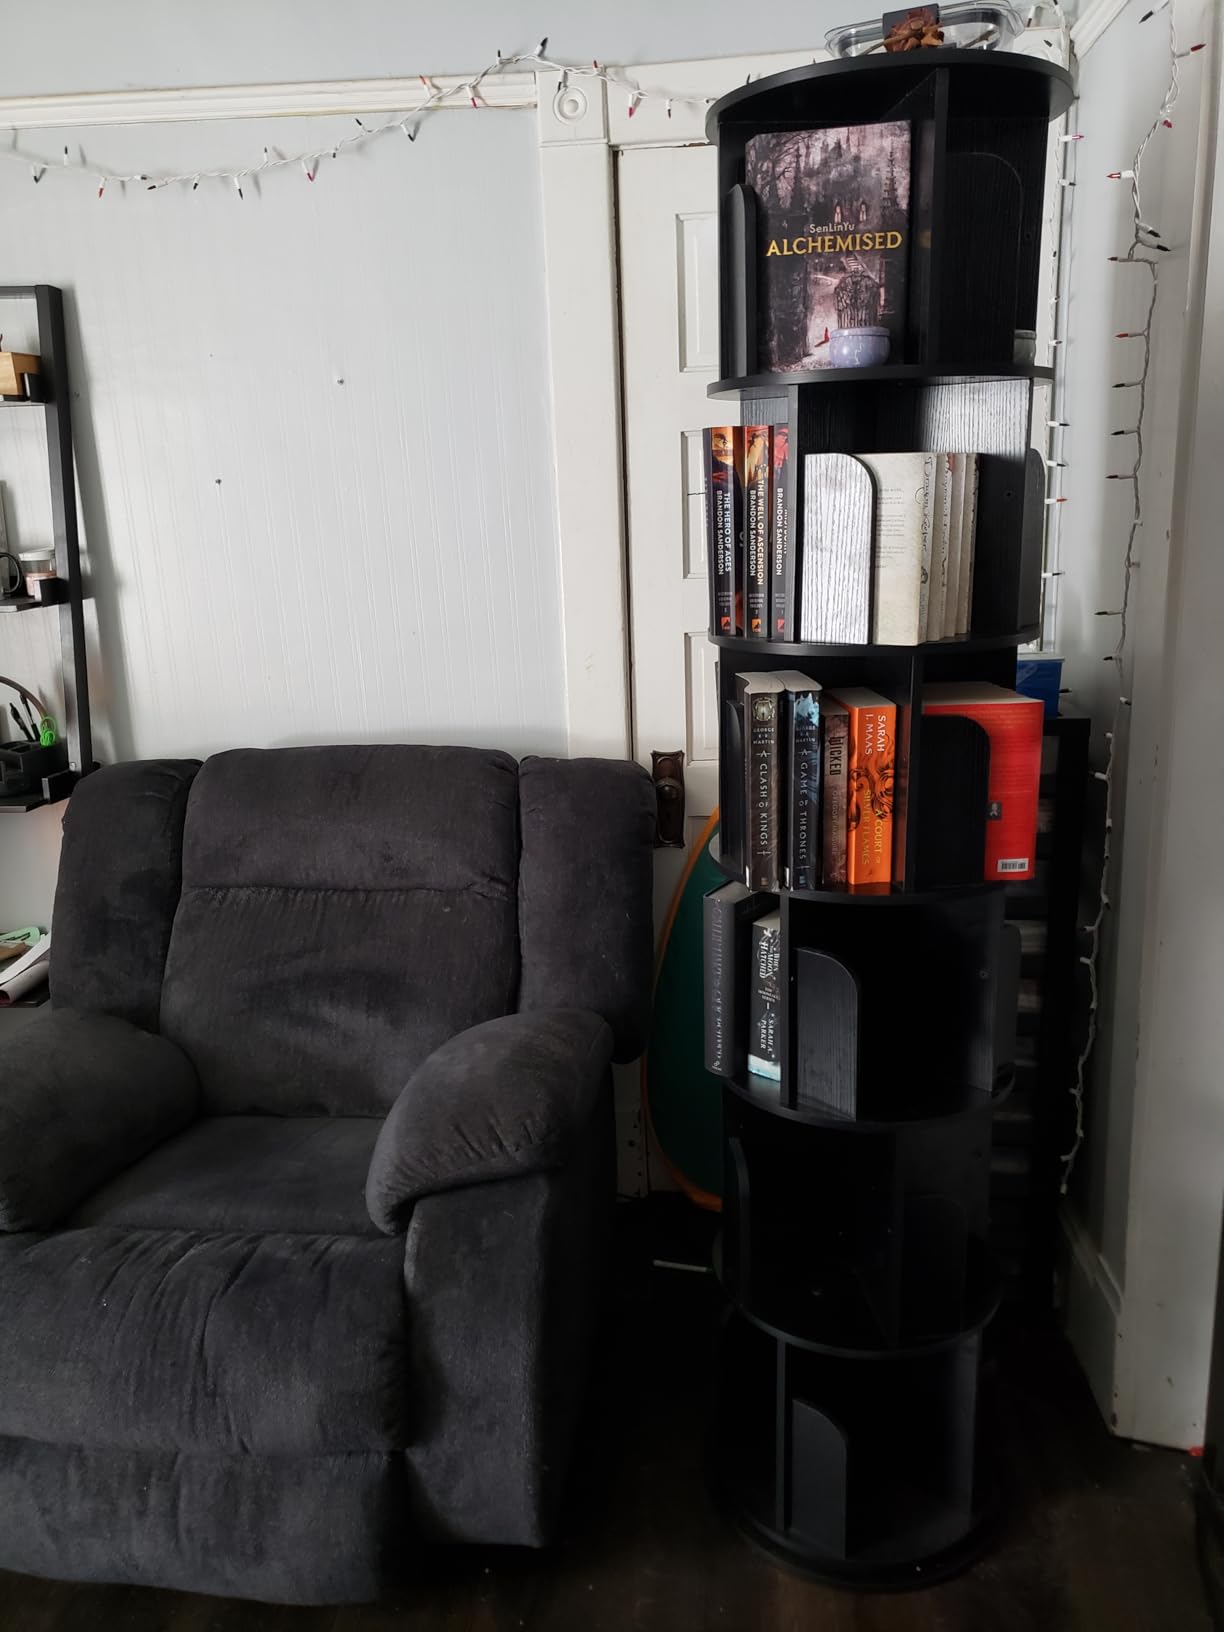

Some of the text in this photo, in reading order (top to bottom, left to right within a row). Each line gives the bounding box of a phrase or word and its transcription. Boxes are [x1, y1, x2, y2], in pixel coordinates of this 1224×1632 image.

[766, 231, 902, 257] ALCHEMISED
[809, 222, 855, 234] SenLinYu
[724, 536, 731, 548] OF
[757, 522, 764, 534] OF
[724, 550, 732, 572] AGES
[865, 723, 873, 755] MAAS
[877, 714, 886, 752] SARAH
[828, 736, 845, 776] WICKED
[760, 763, 768, 797] CLASH
[800, 762, 808, 795] GAME
[862, 789, 871, 823] SILVER
[875, 808, 883, 816] A
[760, 812, 768, 846] KINGS
[799, 810, 807, 860] THRONES
[874, 819, 883, 853] COURT
[759, 942, 768, 979] HATCHED
